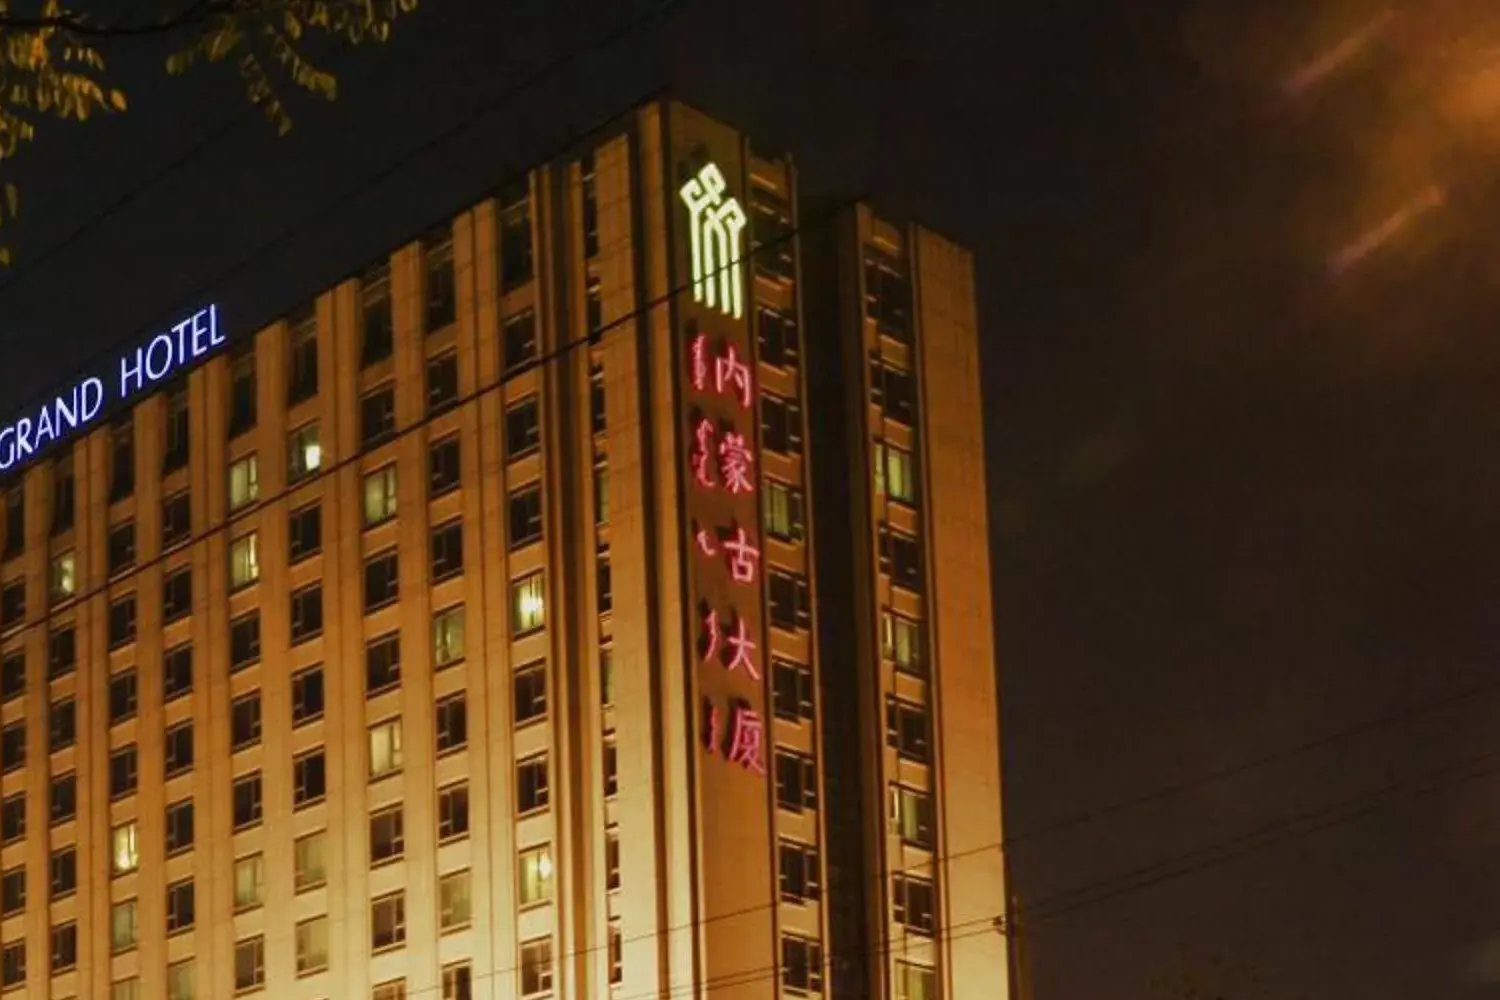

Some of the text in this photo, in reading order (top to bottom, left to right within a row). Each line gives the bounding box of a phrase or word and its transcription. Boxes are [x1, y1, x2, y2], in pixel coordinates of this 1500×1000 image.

[119, 303, 226, 398] HOTEL
[715, 346, 767, 776] 内蒙古大厦
